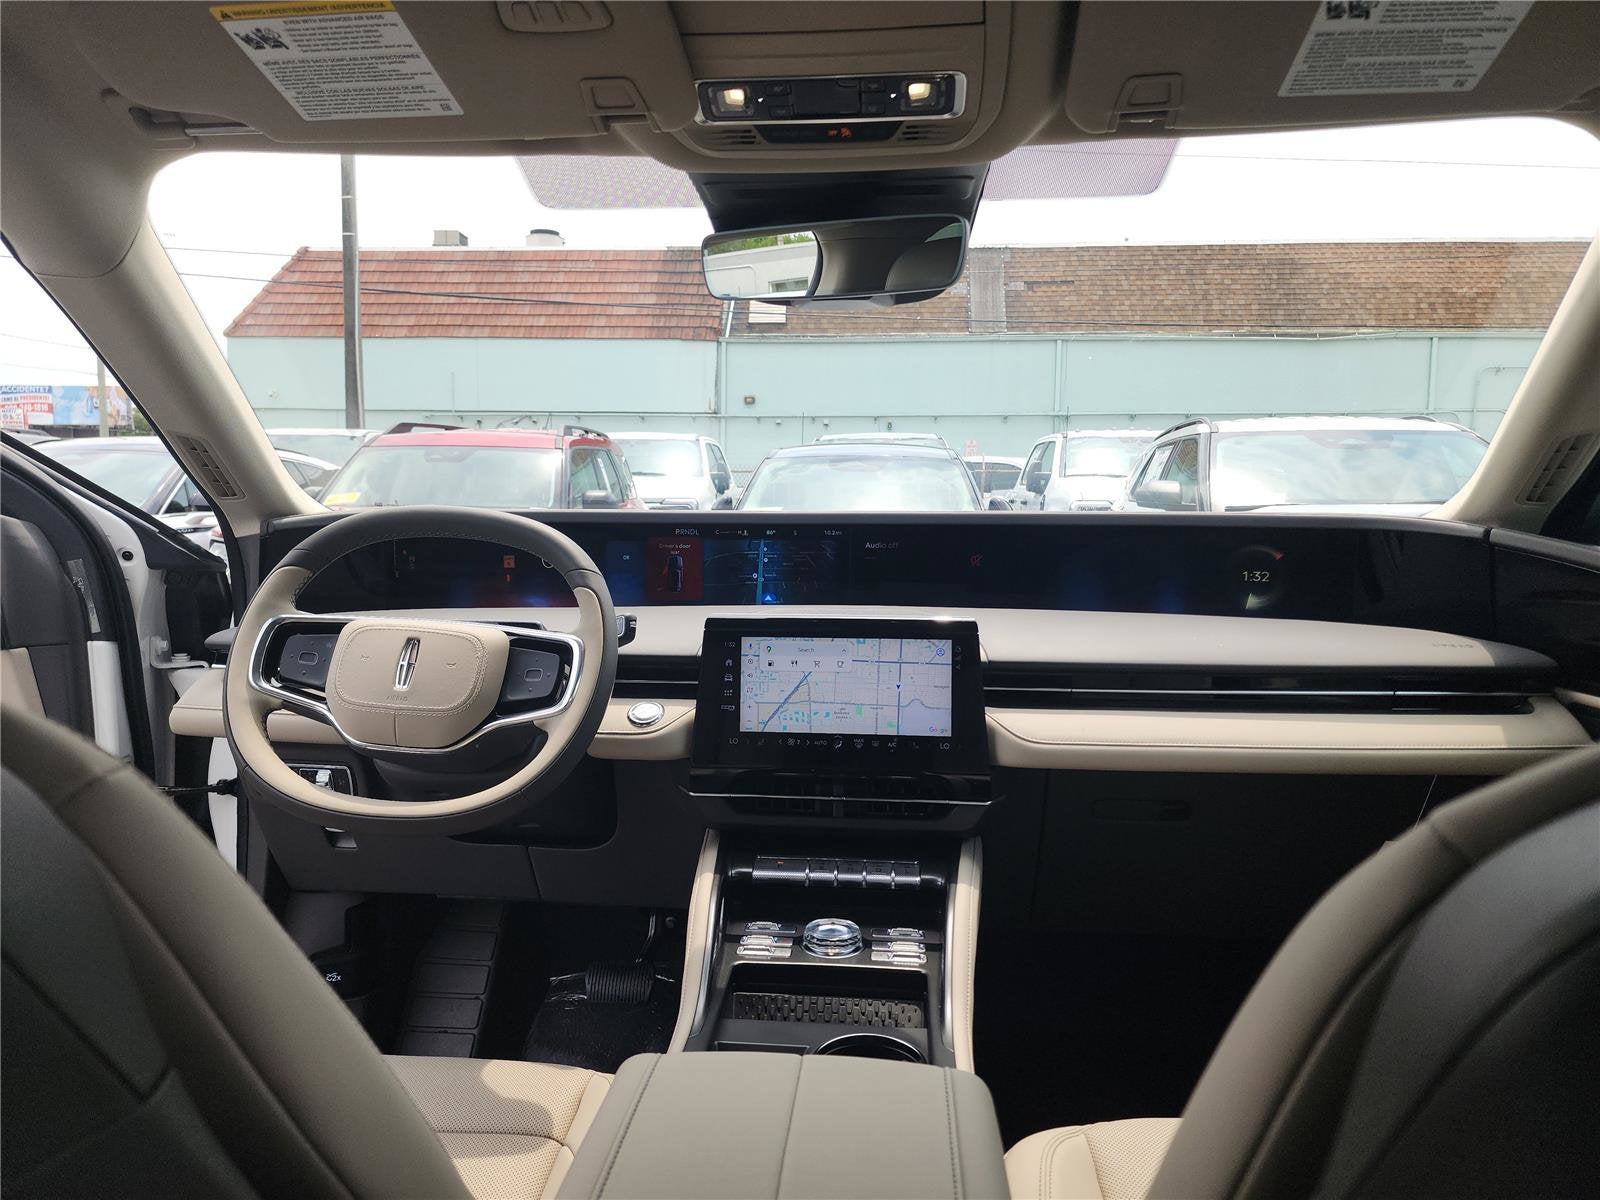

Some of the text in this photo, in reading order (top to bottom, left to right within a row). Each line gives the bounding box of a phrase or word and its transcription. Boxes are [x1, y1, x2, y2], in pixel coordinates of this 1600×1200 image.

[675, 528, 700, 536] PRNDL
[864, 541, 887, 549] Audio
[1241, 571, 1270, 583] 1:32
